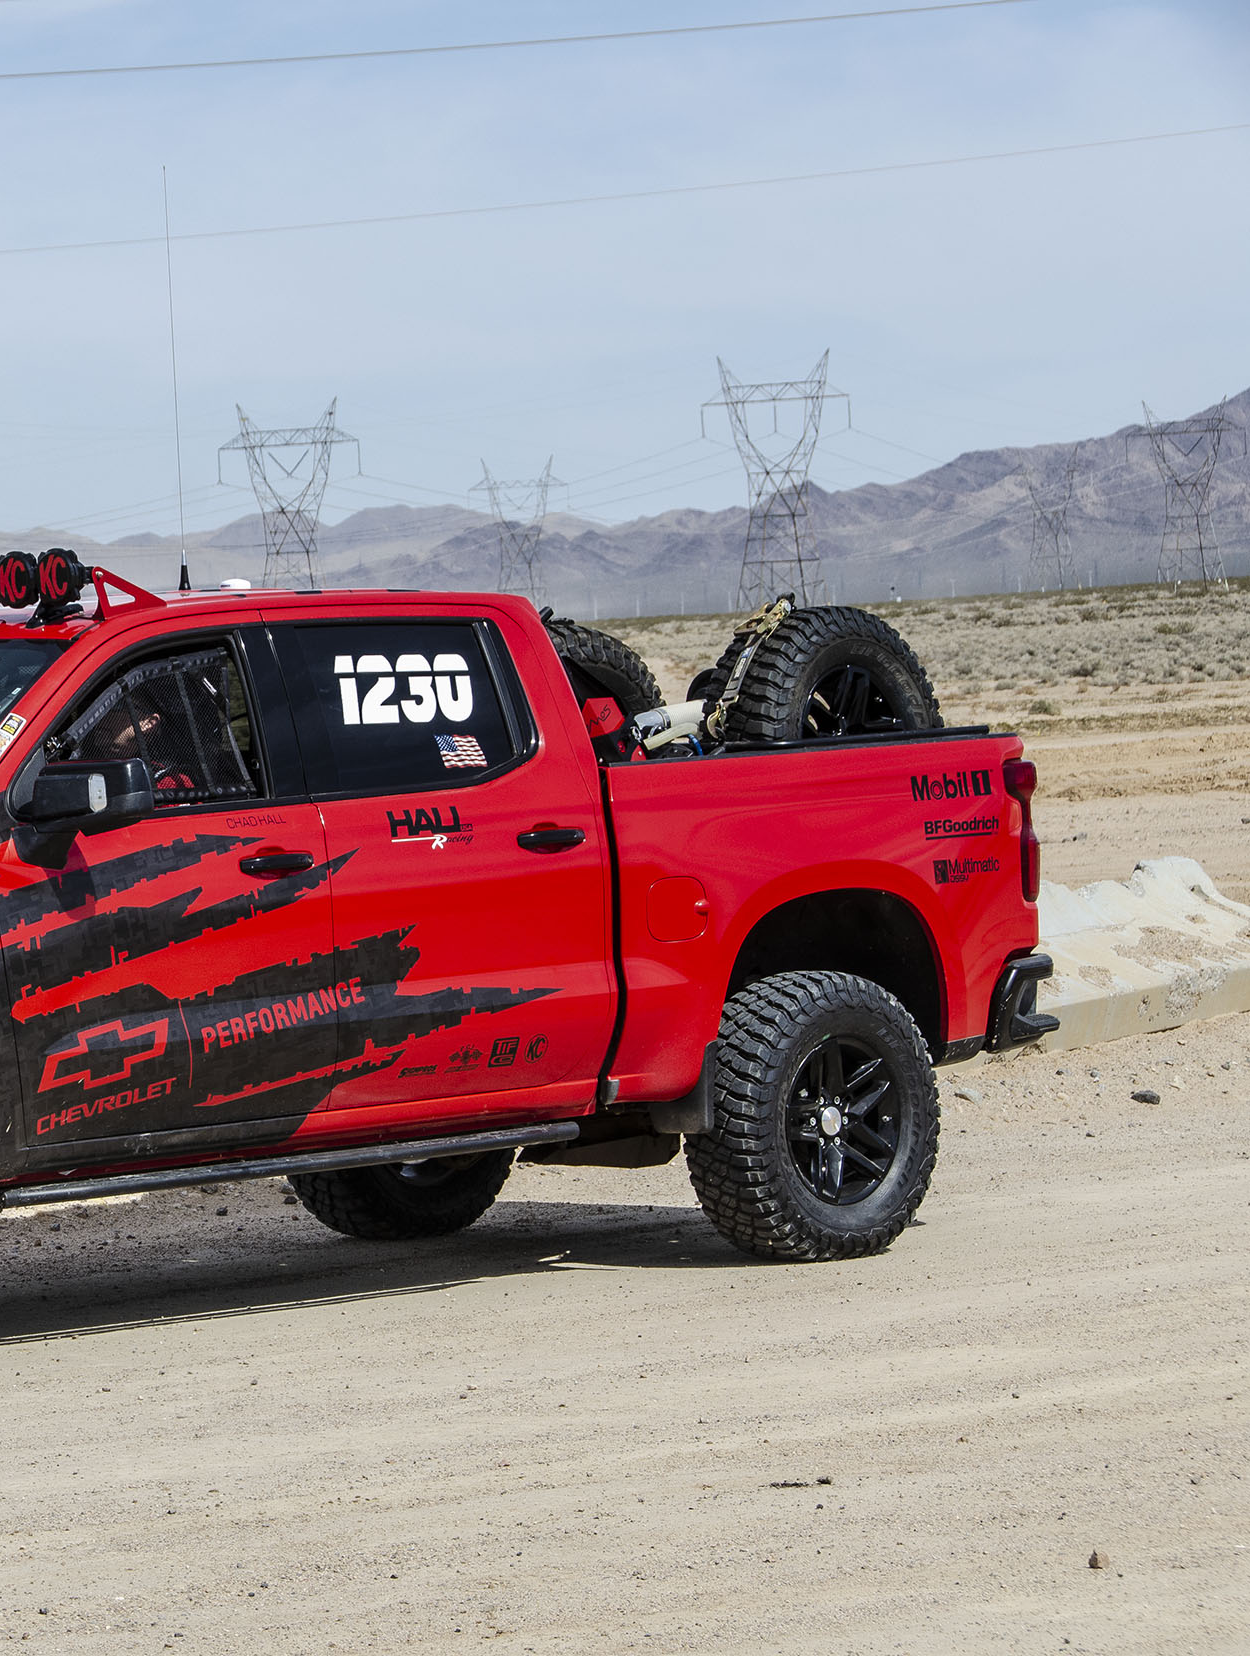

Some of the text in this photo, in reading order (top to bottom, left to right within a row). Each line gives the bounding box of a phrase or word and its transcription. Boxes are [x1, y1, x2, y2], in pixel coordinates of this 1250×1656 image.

[0, 557, 26, 600] KC
[39, 553, 68, 599] KC
[333, 653, 474, 725] 1230
[910, 769, 991, 802] Mobil 1
[226, 813, 287, 829] CHAD HALL
[924, 816, 999, 835] BFGoodrich
[948, 857, 1000, 874] Multimatic
[201, 977, 366, 1054] PERFORMANCE
[526, 1037, 546, 1061] KC
[36, 1077, 177, 1136] CHEVROLET
